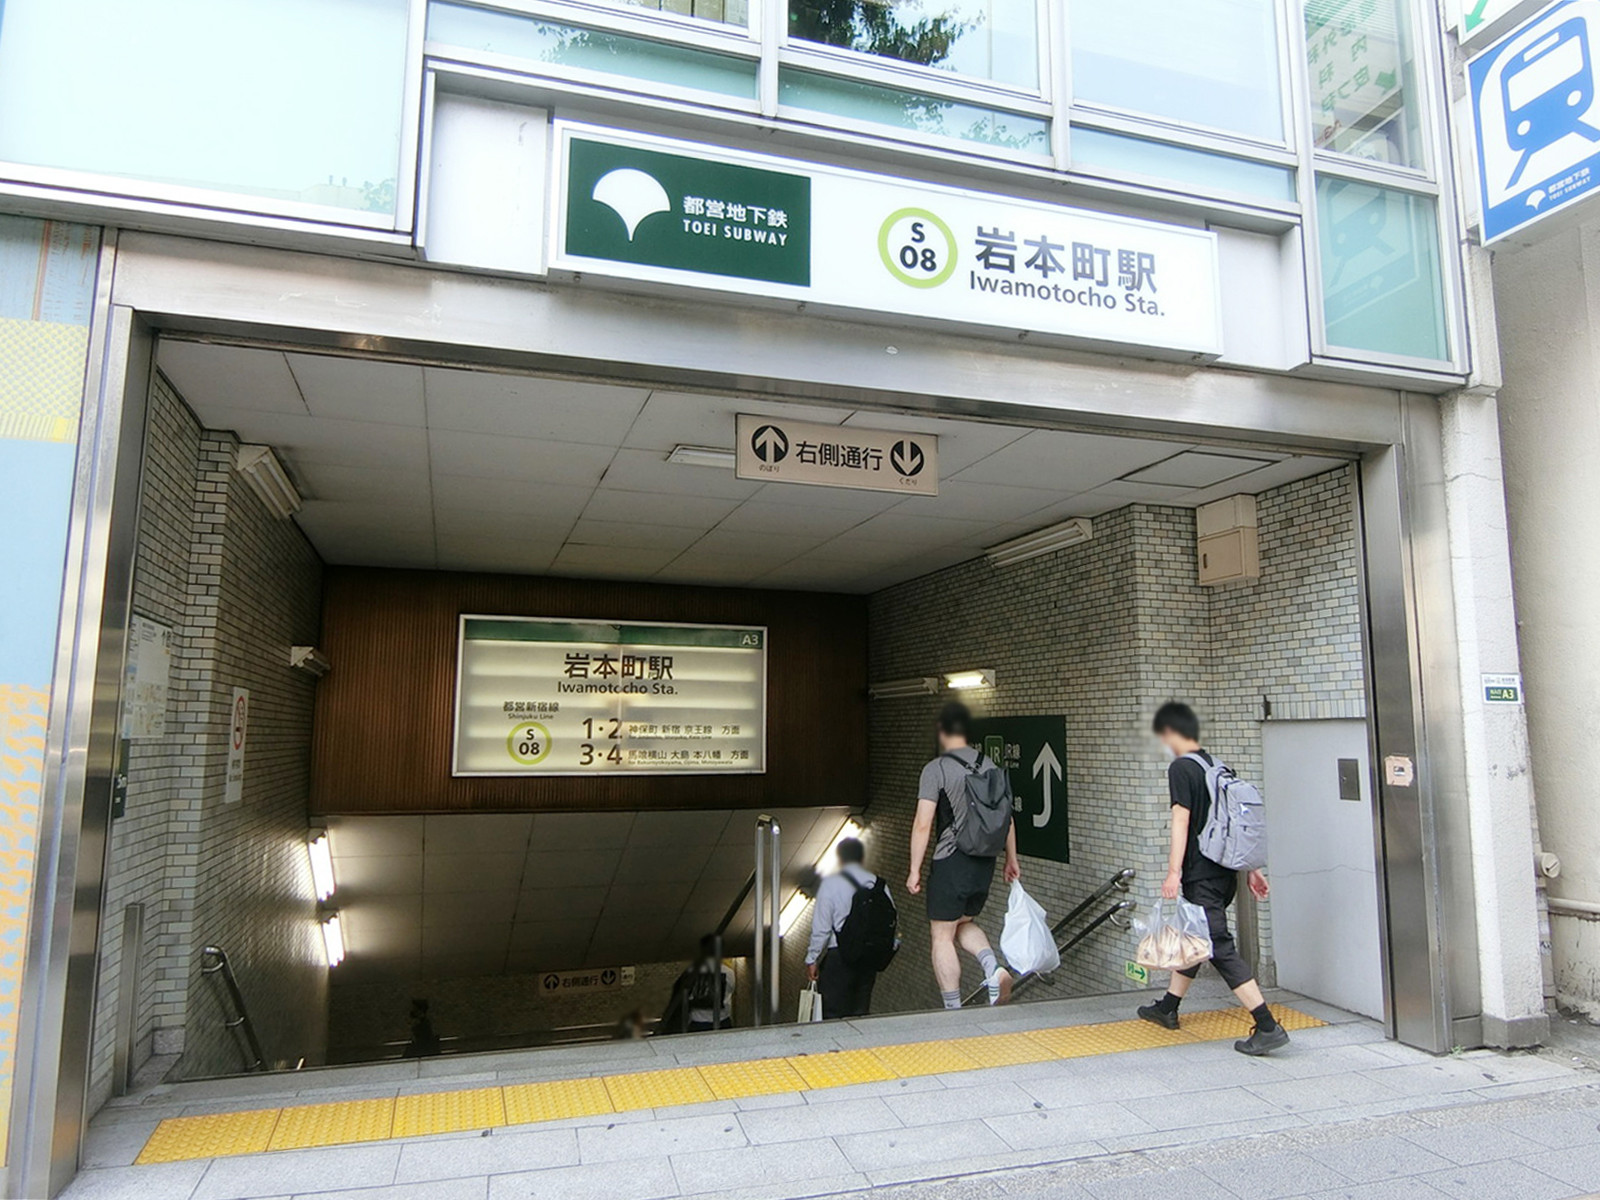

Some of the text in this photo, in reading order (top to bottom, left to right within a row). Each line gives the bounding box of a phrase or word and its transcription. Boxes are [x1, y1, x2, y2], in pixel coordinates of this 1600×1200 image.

[683, 195, 789, 229] 都営地下鉄
[683, 219, 788, 247] TOEI SUBWAY
[911, 222, 926, 243] S
[899, 244, 937, 272] 08
[975, 226, 1158, 294] 岩本町駅
[970, 270, 1166, 317] Iwamotocho Sta.
[795, 441, 884, 471] 右側通行
[742, 634, 759, 646] A3
[564, 653, 674, 680] 岩本町駅
[557, 681, 679, 695] Iwamotocho Sta.
[1502, 689, 1515, 700] A3
[526, 728, 535, 741] S
[518, 742, 540, 755] 08
